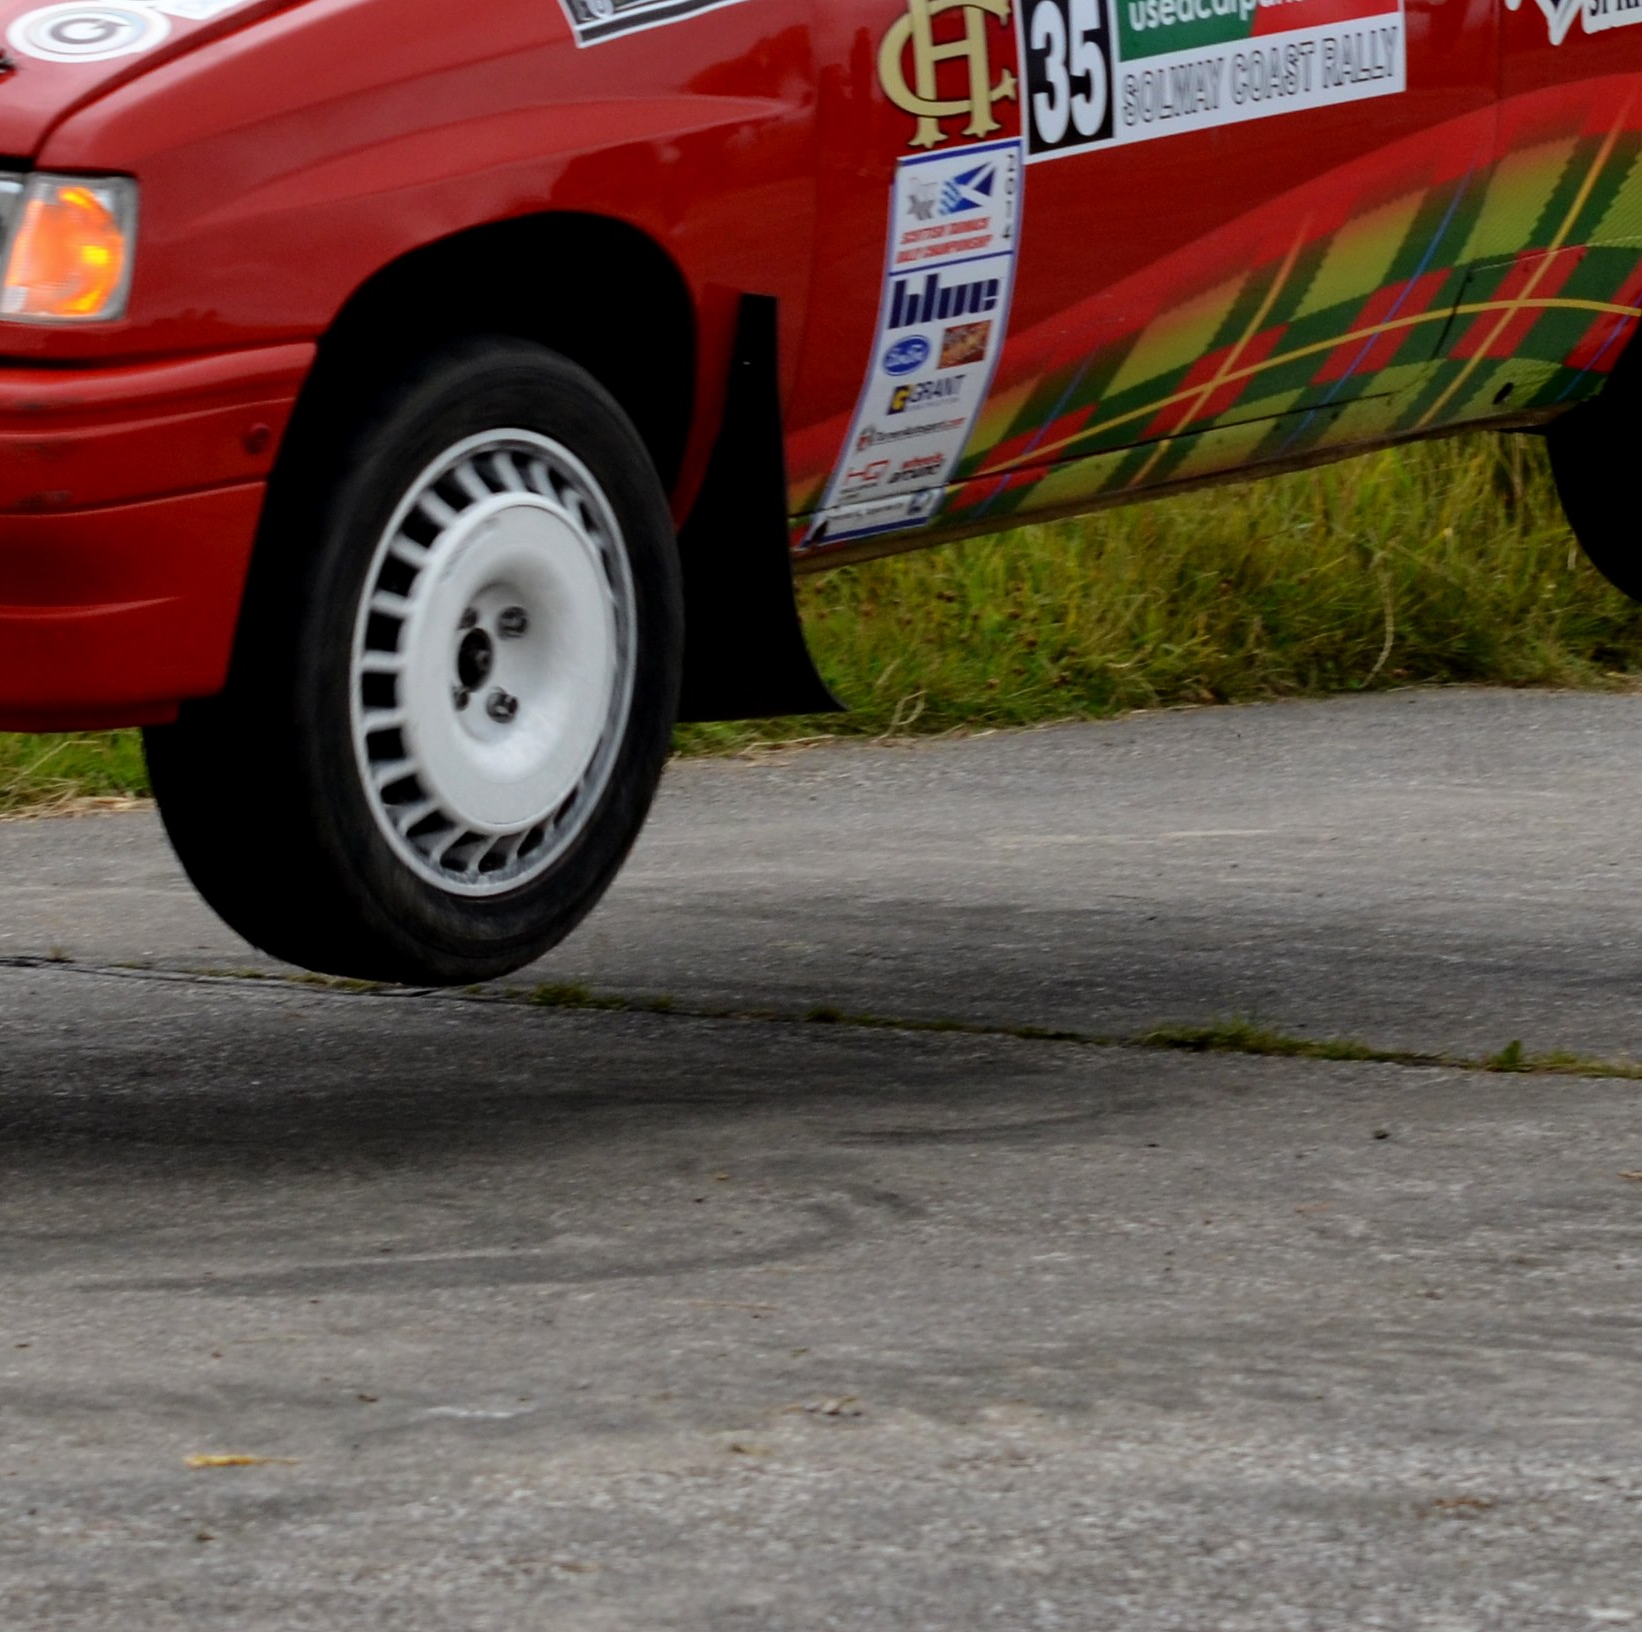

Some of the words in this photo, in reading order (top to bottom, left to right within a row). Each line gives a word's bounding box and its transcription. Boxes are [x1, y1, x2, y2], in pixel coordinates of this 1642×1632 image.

[1122, 57, 1225, 126] SOLWAY
[1231, 40, 1316, 106] COAST
[1322, 25, 1399, 89] RALLY
[888, 273, 999, 329] blue
[910, 374, 966, 403] GRANT
